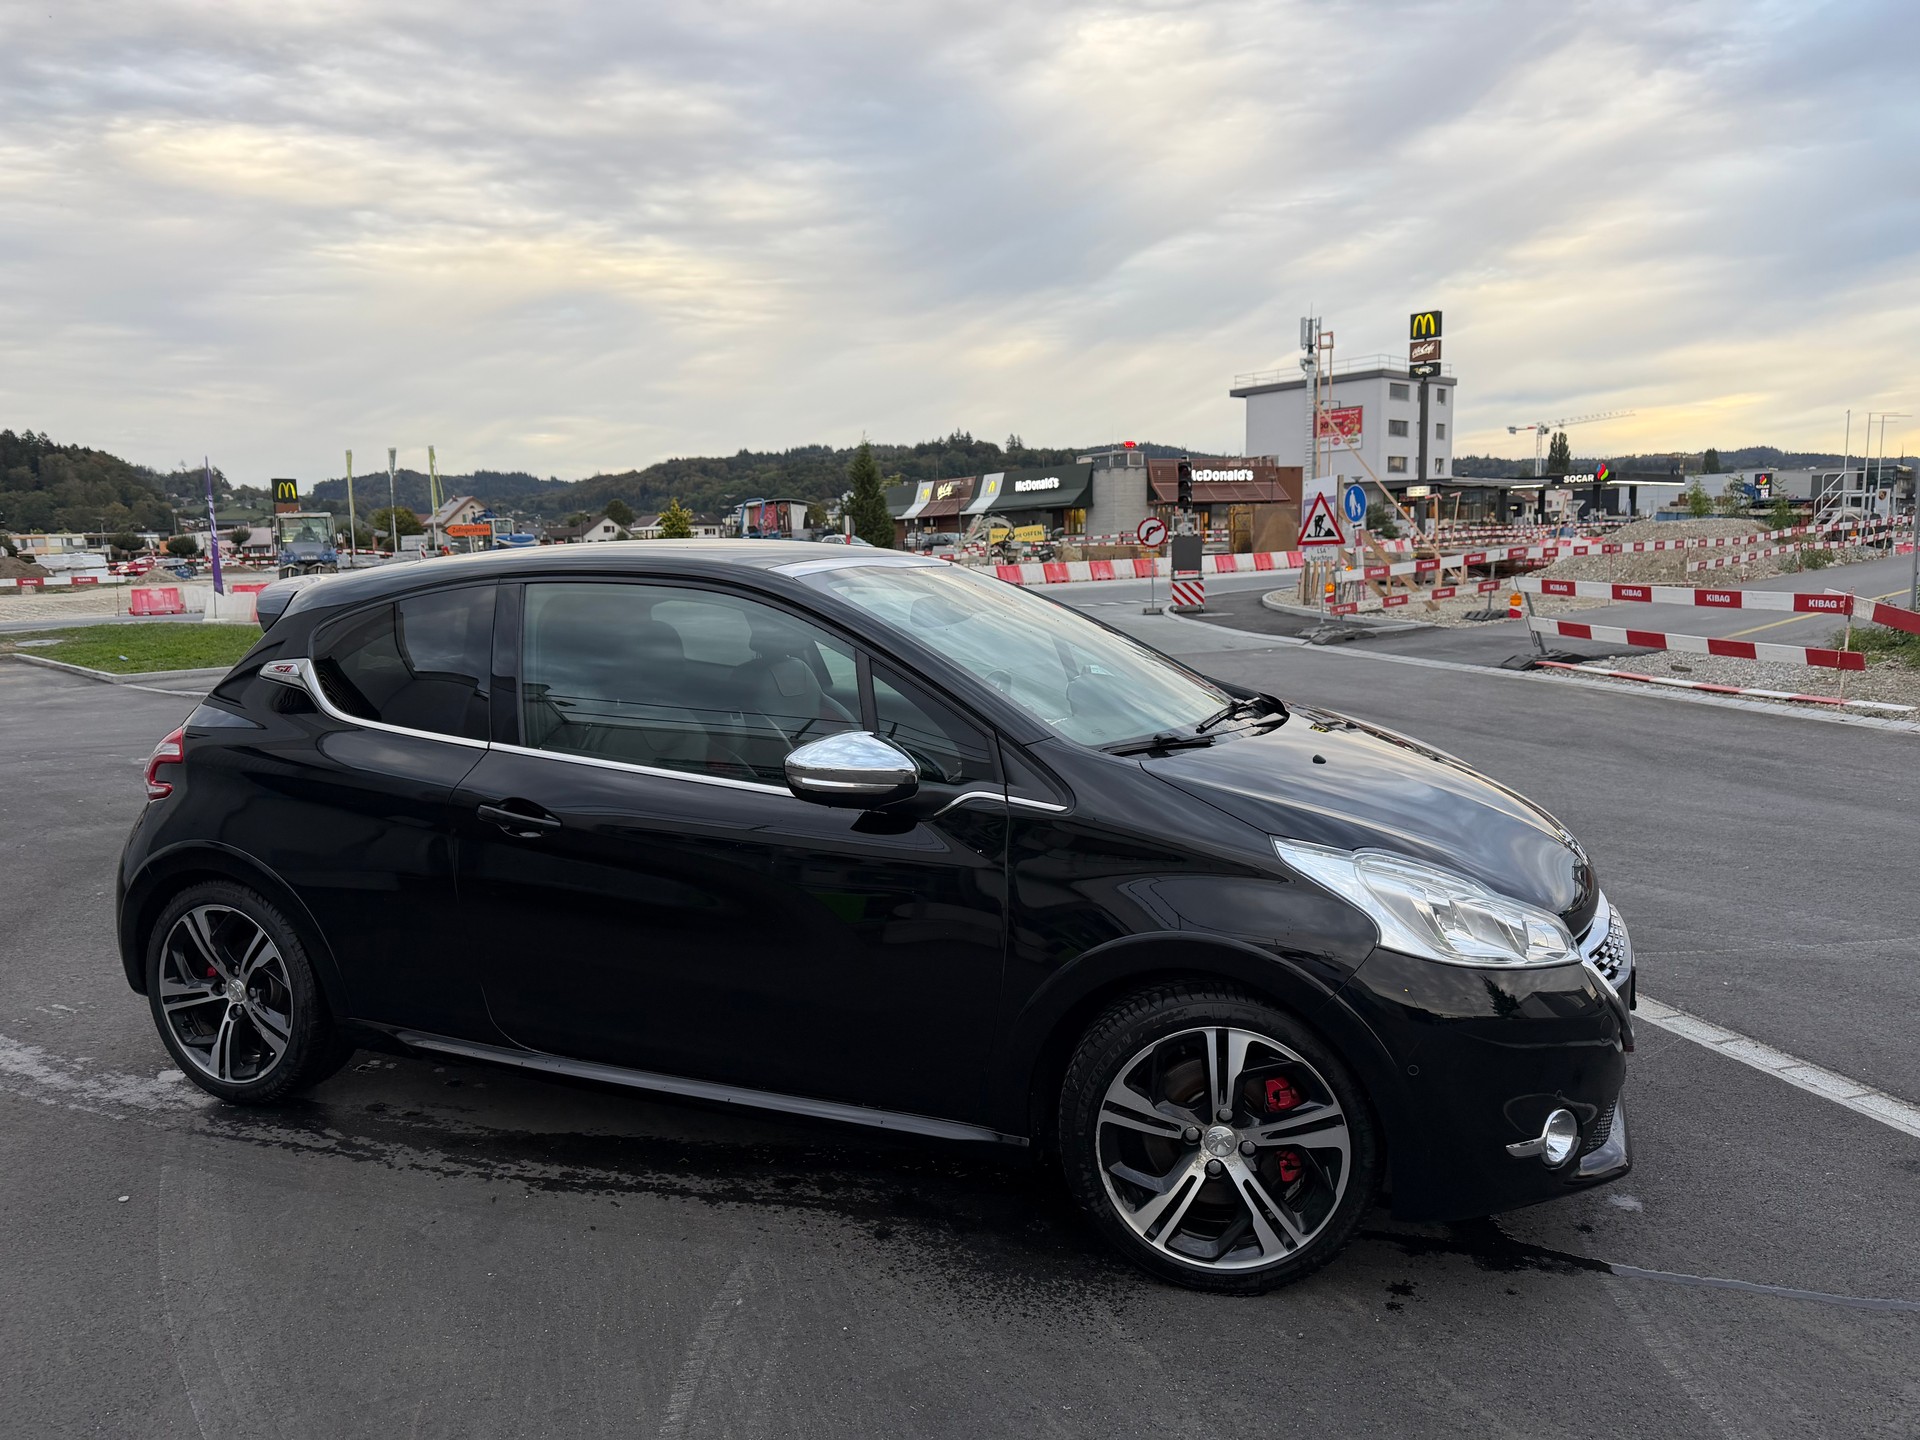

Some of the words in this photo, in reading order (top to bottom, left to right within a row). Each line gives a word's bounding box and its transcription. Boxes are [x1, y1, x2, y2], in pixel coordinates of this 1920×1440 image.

[1563, 474, 1594, 483] SOCAR
[1015, 477, 1059, 492] McDonald's
[1549, 584, 1568, 592] KIBAG
[1621, 589, 1642, 597] KIBAG
[1706, 593, 1731, 603] KIBAG
[1808, 598, 1837, 609] KIBAG
